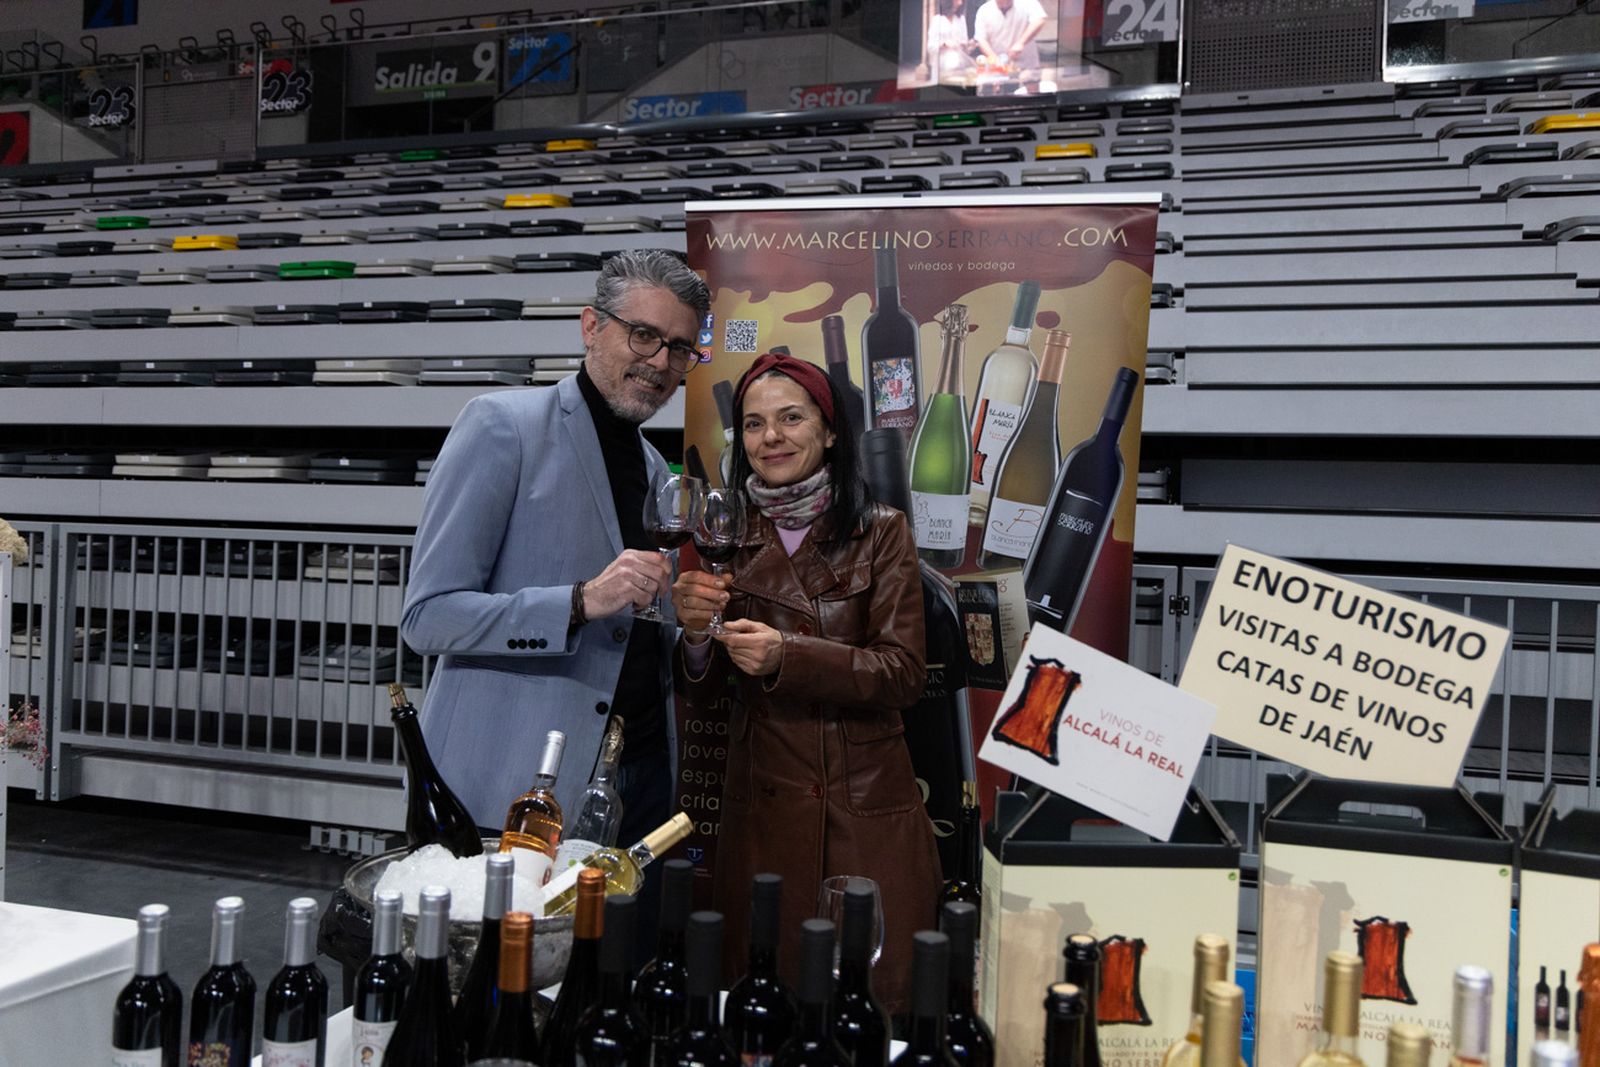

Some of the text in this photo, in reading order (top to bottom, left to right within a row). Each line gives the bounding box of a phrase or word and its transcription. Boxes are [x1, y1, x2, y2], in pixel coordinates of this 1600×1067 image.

[1394, 3, 1452, 19] ector
[1107, 0, 1178, 46] 24
[508, 36, 549, 50] Sector
[1104, 28, 1159, 43] ector
[374, 41, 497, 90] Salida 9
[261, 69, 313, 113] 23
[789, 87, 872, 109] Sector
[89, 87, 136, 125] 23
[259, 99, 299, 113] Sector
[624, 98, 702, 120] Sector
[88, 113, 124, 126] Sector
[908, 260, 1015, 273] viñedos y bodega
[1233, 559, 1487, 660] ENOTURISMO
[1219, 604, 1473, 709] VISITAS A BODEGA
[1216, 650, 1447, 744] CATAS DE VINOS
[684, 719, 728, 736] rosa
[1099, 709, 1166, 748] VINOS DE
[1258, 704, 1374, 761] DE JAÉN
[682, 740, 727, 761] jove
[1062, 714, 1185, 779] ALCALÁ LA REAL
[680, 792, 720, 811] cria
[1428, 1018, 1451, 1030] REA
